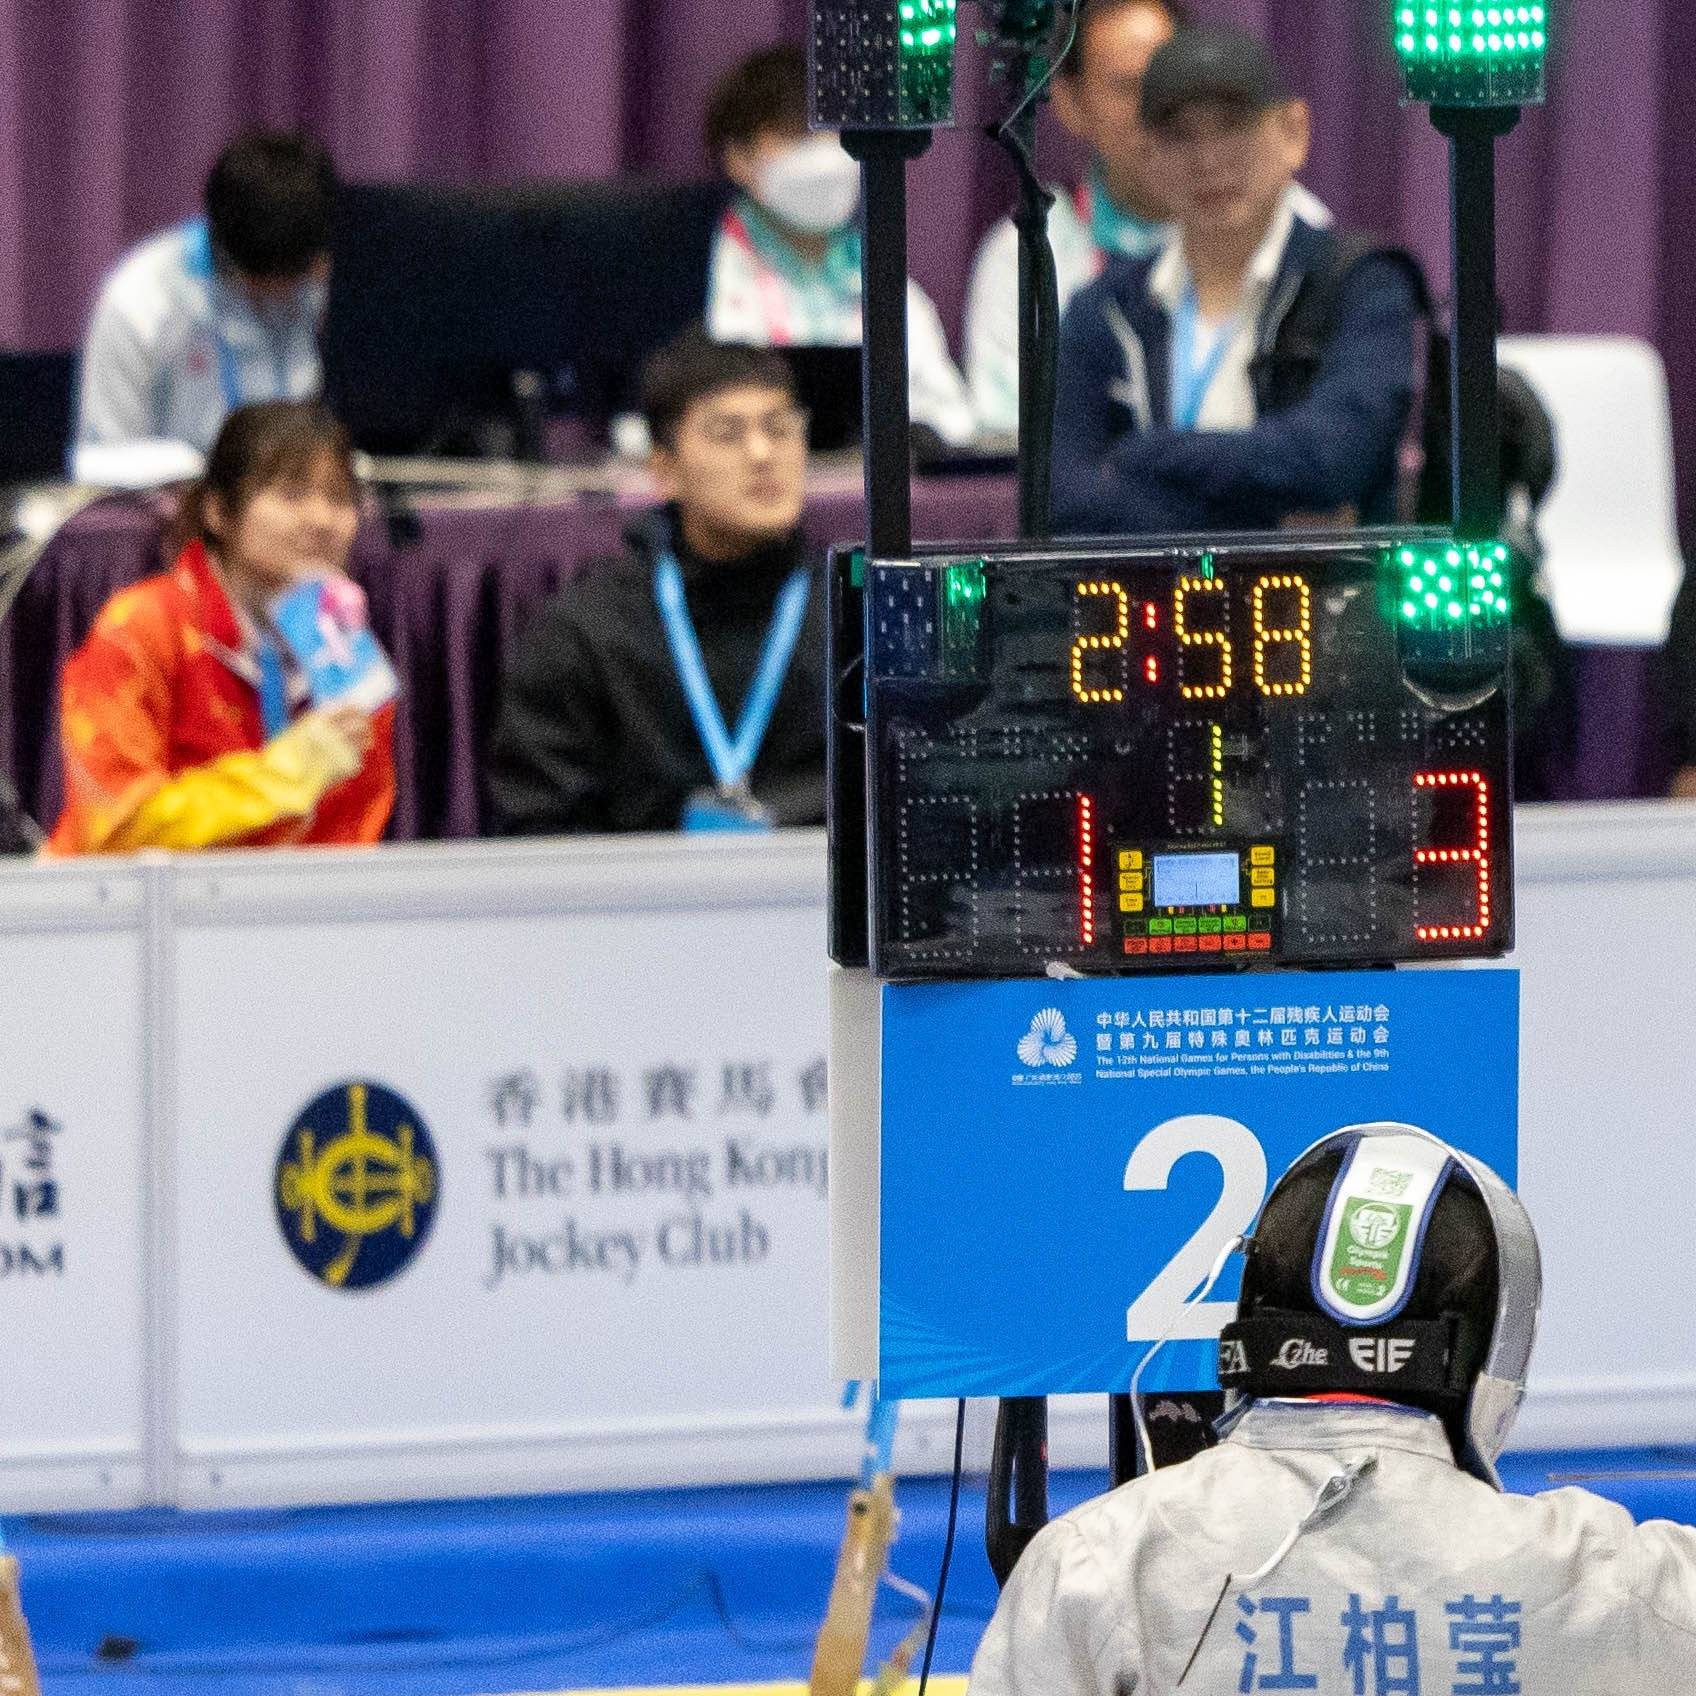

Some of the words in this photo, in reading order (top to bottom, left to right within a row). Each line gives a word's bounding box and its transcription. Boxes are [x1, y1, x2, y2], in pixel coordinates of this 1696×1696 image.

[1070, 574, 1314, 704] 2:58
[1078, 793, 1095, 946] 1
[1414, 772, 1490, 941] 3
[1096, 1004, 1390, 1029] 中华人民共和国第十二届残疾人运动会
[487, 1146, 574, 1199] The
[590, 1141, 711, 1202] Hong
[1122, 1113, 1268, 1343] 2
[483, 1217, 641, 1291] Jockey
[657, 1204, 771, 1268] Club
